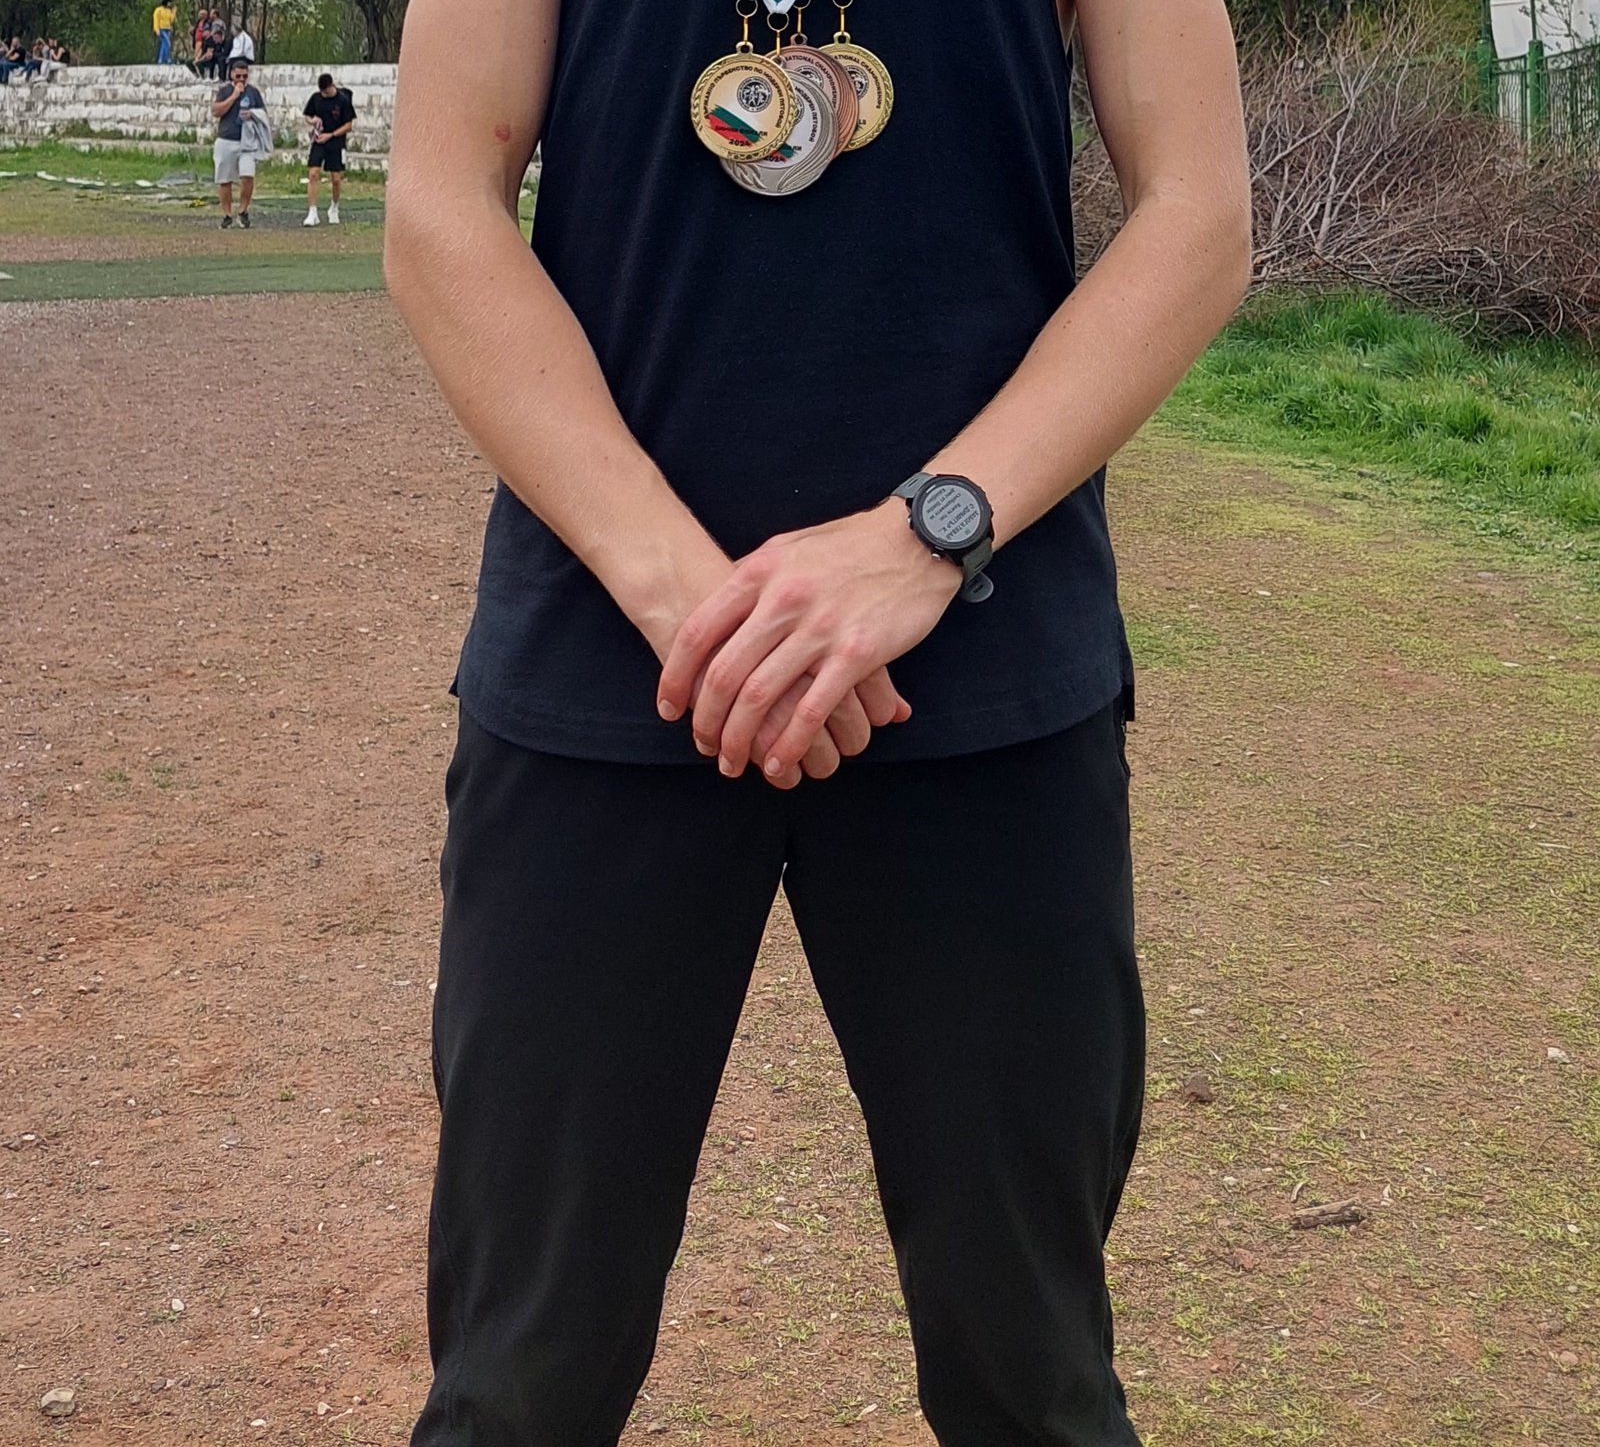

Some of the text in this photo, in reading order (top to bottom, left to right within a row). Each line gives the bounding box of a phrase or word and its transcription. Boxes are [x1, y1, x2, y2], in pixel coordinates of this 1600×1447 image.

[834, 54, 860, 64] ATIONAL
[714, 65, 753, 83] ПЪРВЕНСТВО
[763, 71, 783, 95] МОДЕРЕН
[815, 61, 838, 108] CHAMPIONSHIP
[795, 86, 815, 111] МОДЕРЕН
[728, 139, 752, 147] 2024
